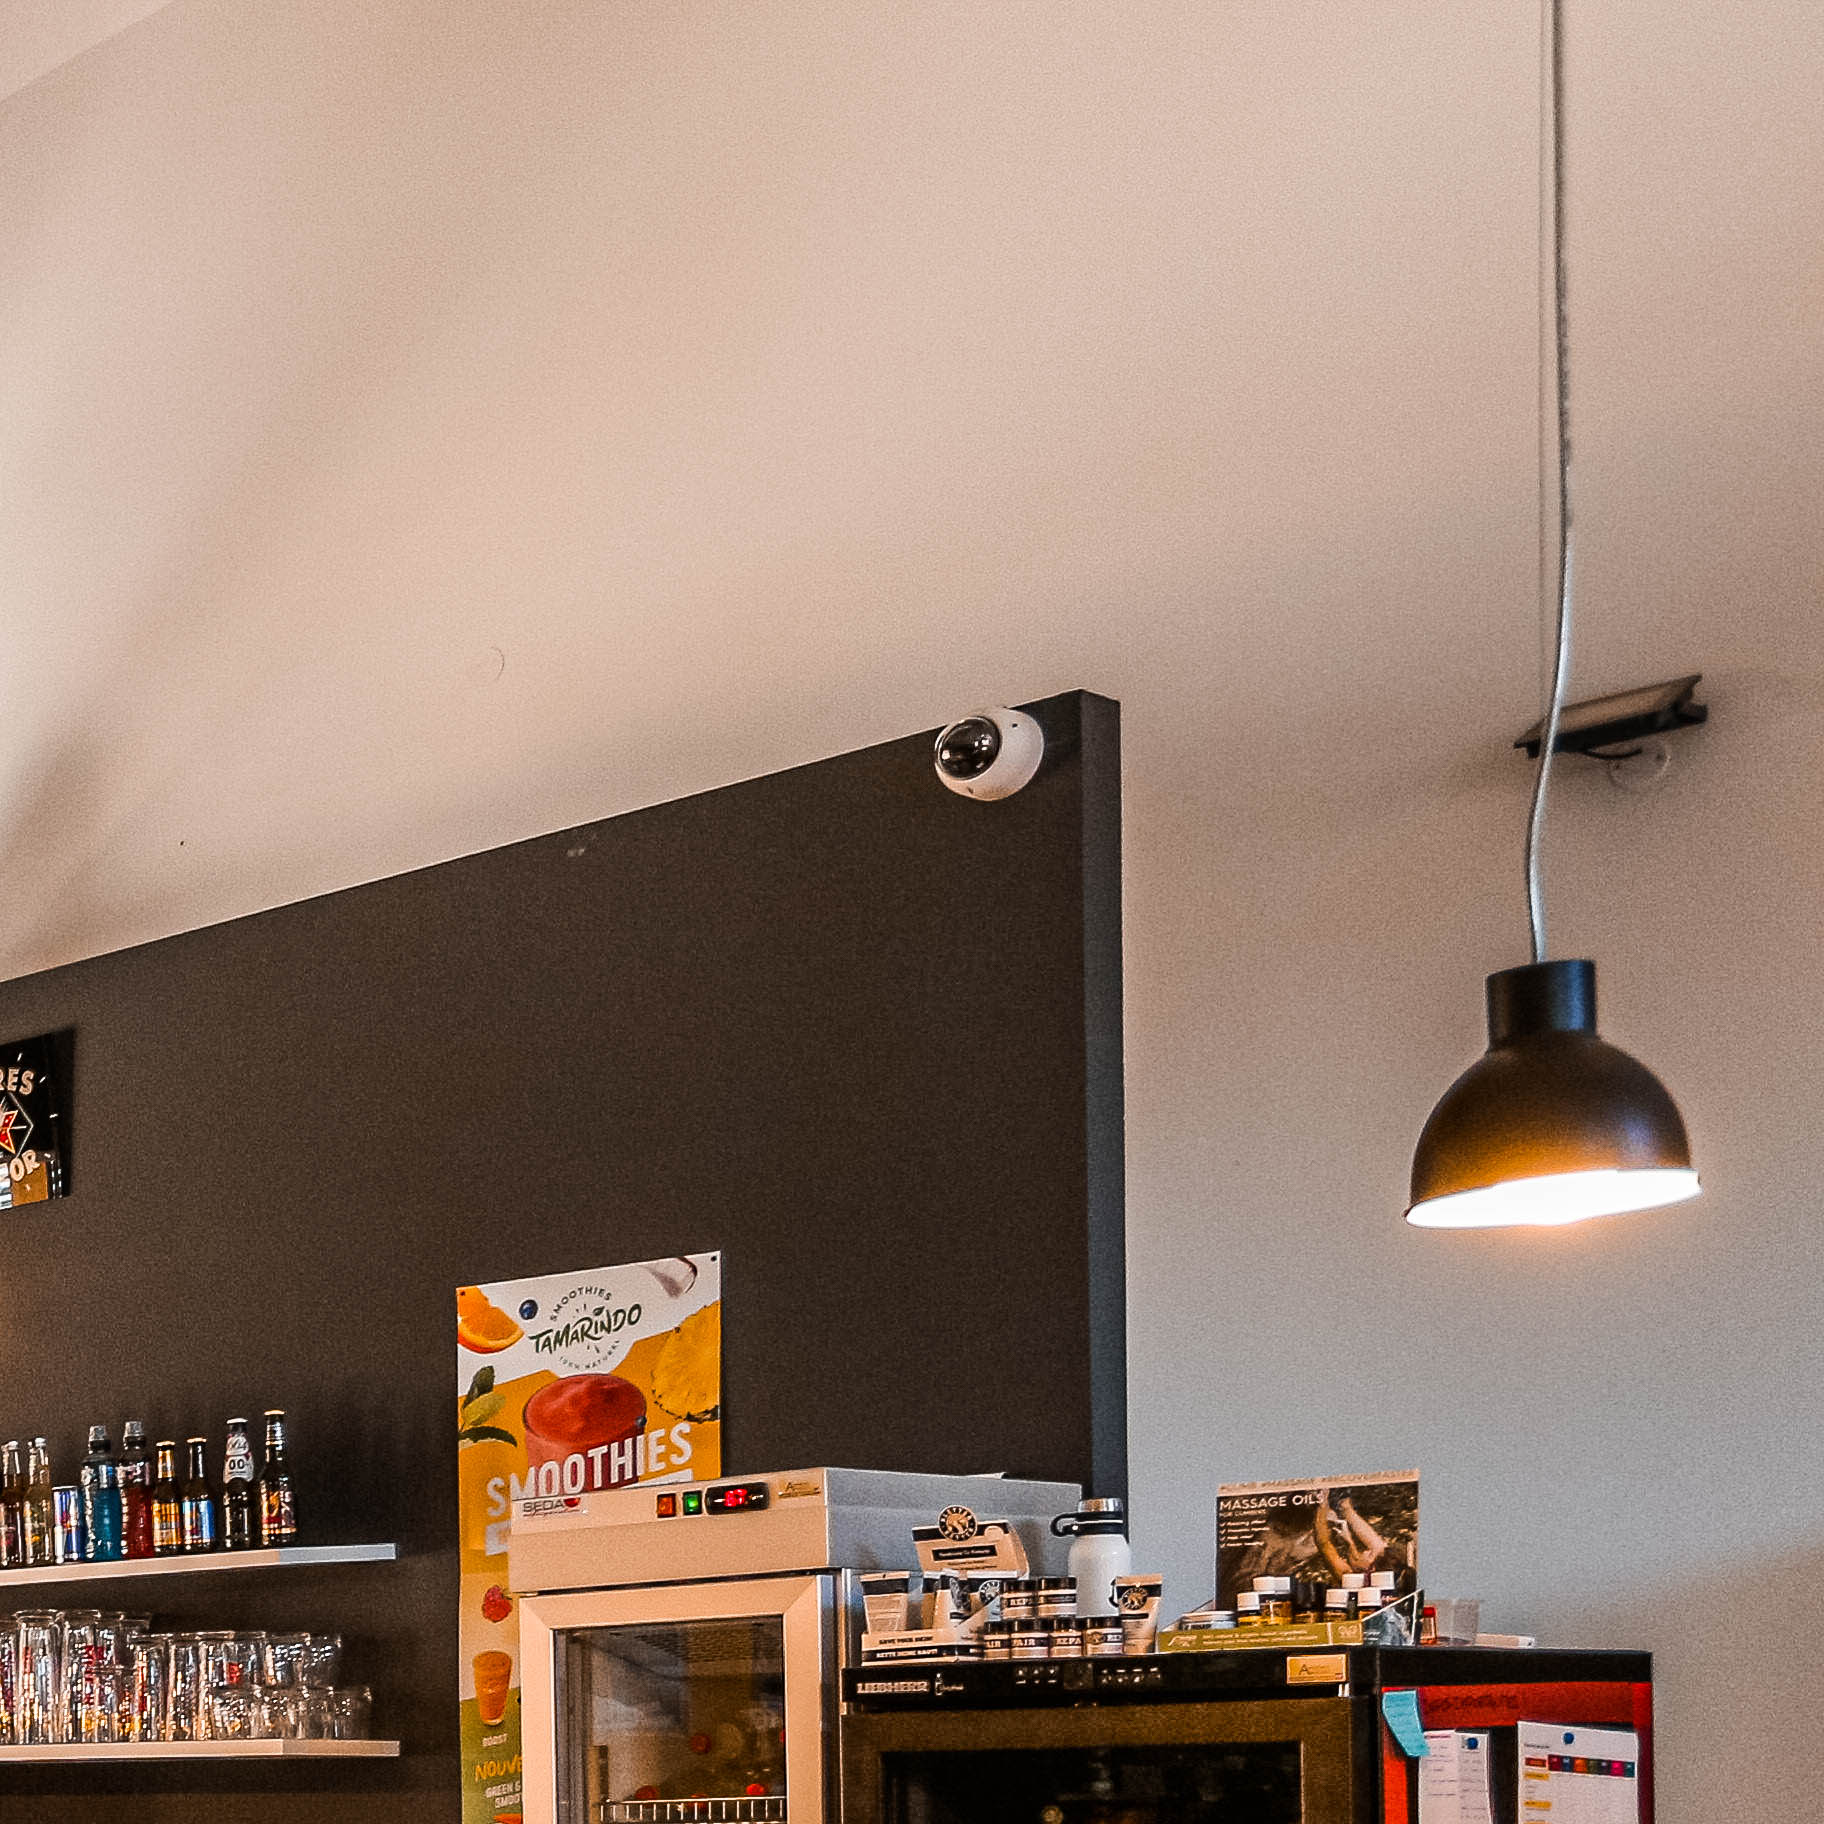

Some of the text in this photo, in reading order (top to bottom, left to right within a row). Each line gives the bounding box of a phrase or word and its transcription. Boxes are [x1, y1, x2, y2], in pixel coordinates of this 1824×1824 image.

[550, 1286, 611, 1321] SMOOTHIES
[528, 1304, 642, 1354] TAMARINDO
[486, 1421, 693, 1517] SMOOTHIES
[1220, 1493, 1324, 1511] MASSAGE OILS
